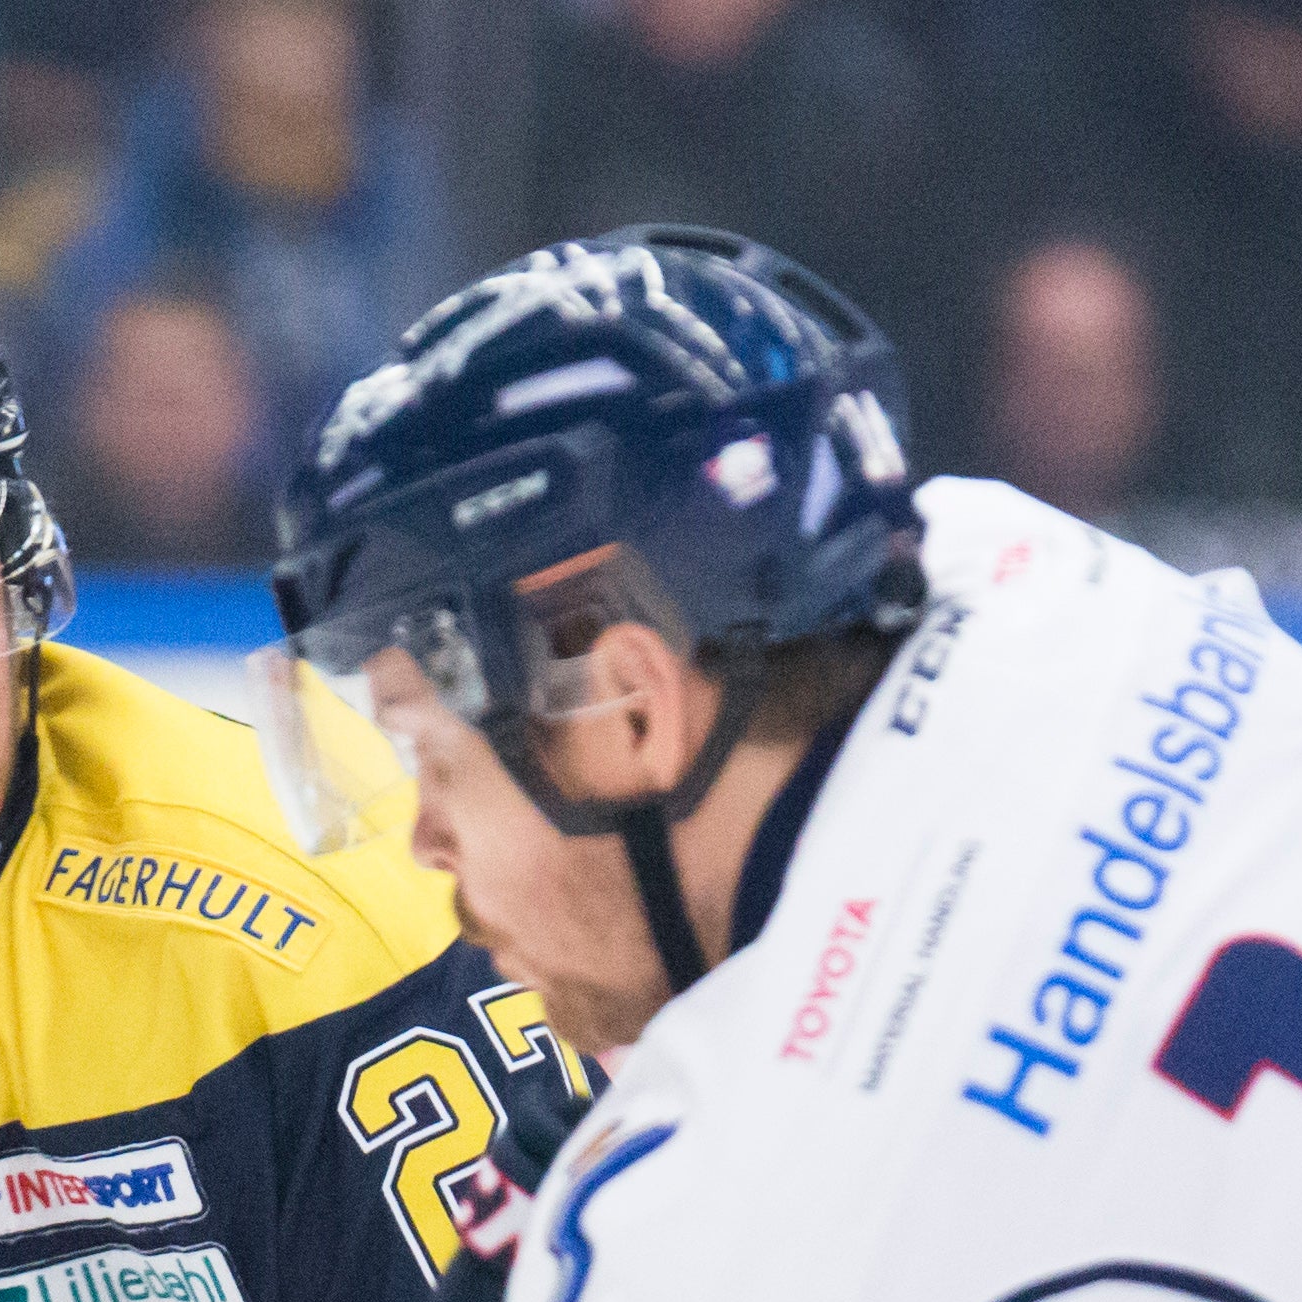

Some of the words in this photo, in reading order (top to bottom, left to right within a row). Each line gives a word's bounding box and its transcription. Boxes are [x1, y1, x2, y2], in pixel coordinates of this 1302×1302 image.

[45, 847, 316, 952] FAGERHULT
[780, 897, 881, 1062] TOYOTA
[338, 982, 594, 1290] 27
